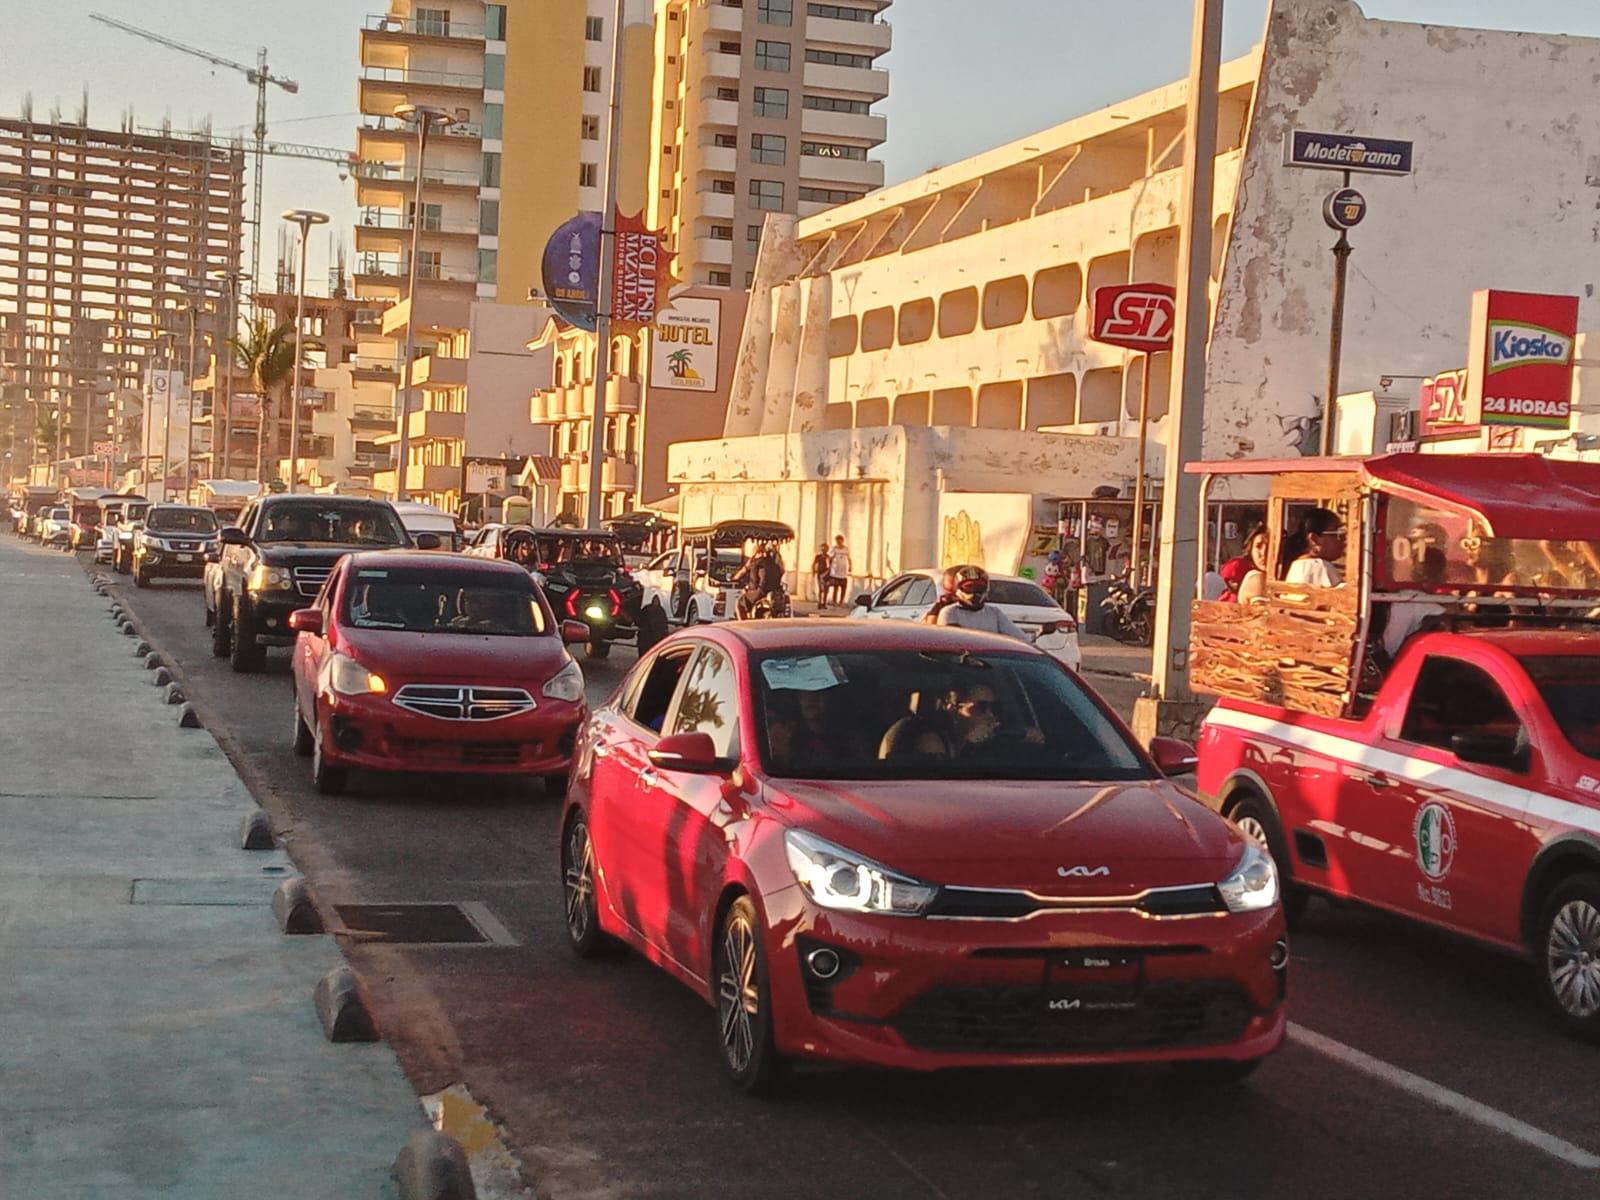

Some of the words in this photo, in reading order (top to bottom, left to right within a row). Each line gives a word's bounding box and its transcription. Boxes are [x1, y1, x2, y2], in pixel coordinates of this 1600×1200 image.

[622, 232, 639, 321] MAZATLAN
[637, 234, 657, 322] ECLIPSE
[659, 324, 713, 345] HOTEL
[1493, 330, 1563, 361] Kiosko
[1483, 397, 1506, 412] 24
[1509, 399, 1569, 416] HORAS
